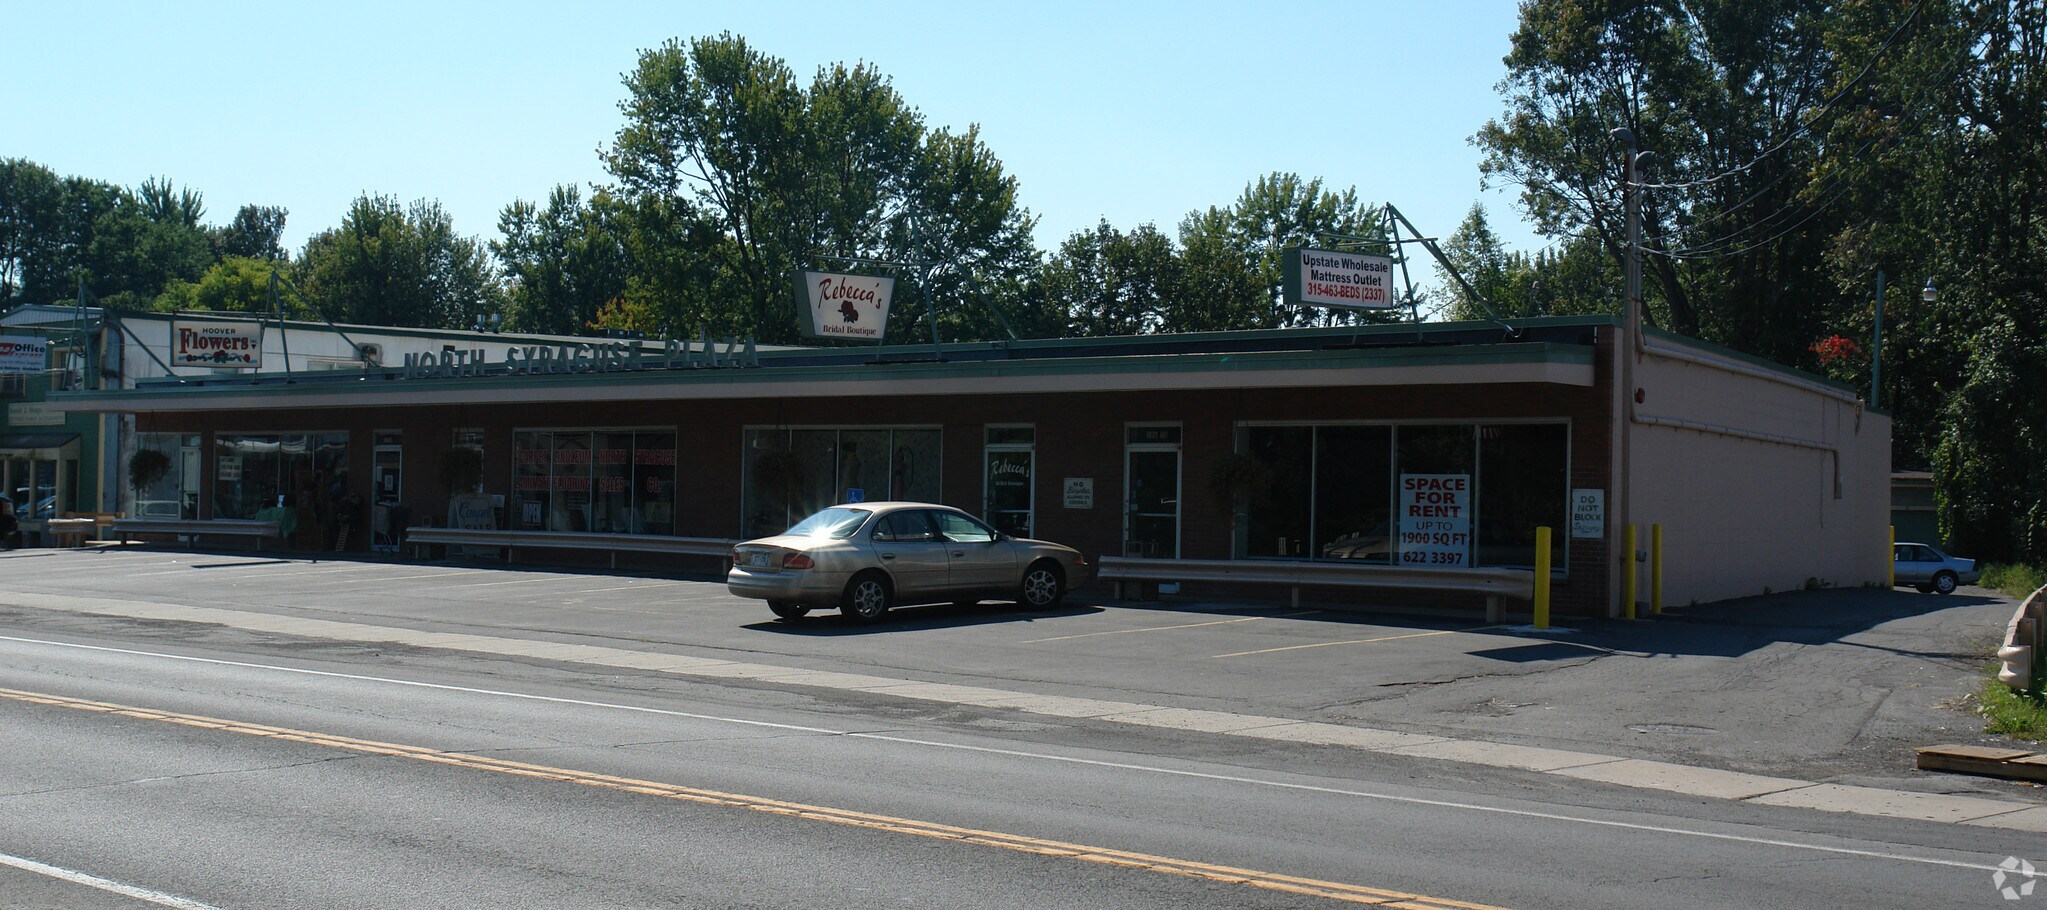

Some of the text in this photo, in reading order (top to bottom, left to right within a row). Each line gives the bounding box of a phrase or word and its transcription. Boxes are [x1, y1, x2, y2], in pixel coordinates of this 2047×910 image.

[1303, 254, 1388, 272] Upstate Wholesale
[1311, 269, 1381, 286] Mattress Outlet
[818, 276, 882, 310] Rebecca's
[1308, 283, 1385, 303] 315-463-BEDS (2337)
[202, 327, 236, 335] HOOVER
[823, 324, 877, 337] Bridal Boutique
[14, 343, 46, 353] Office
[179, 327, 249, 354] Flowers
[404, 334, 760, 378] NORTH SYRACUSE PLAZA
[599, 448, 627, 465] NORTH
[634, 448, 677, 466] SYRACUSE
[990, 457, 1030, 479] Rebecca's
[599, 476, 625, 492] SALES
[1404, 478, 1465, 491] SPACE
[1415, 492, 1455, 504] FOR
[1580, 495, 1596, 504] DO
[459, 501, 492, 522] Carpet
[523, 502, 541, 524] OPEN
[1409, 505, 1461, 517] RENT
[1577, 504, 1599, 512] NOT
[1574, 513, 1601, 521] BLOCK
[1416, 521, 1453, 531] UP TO
[1401, 532, 1467, 546] 1900 SQ FT
[1403, 551, 1463, 564] 622 3397
